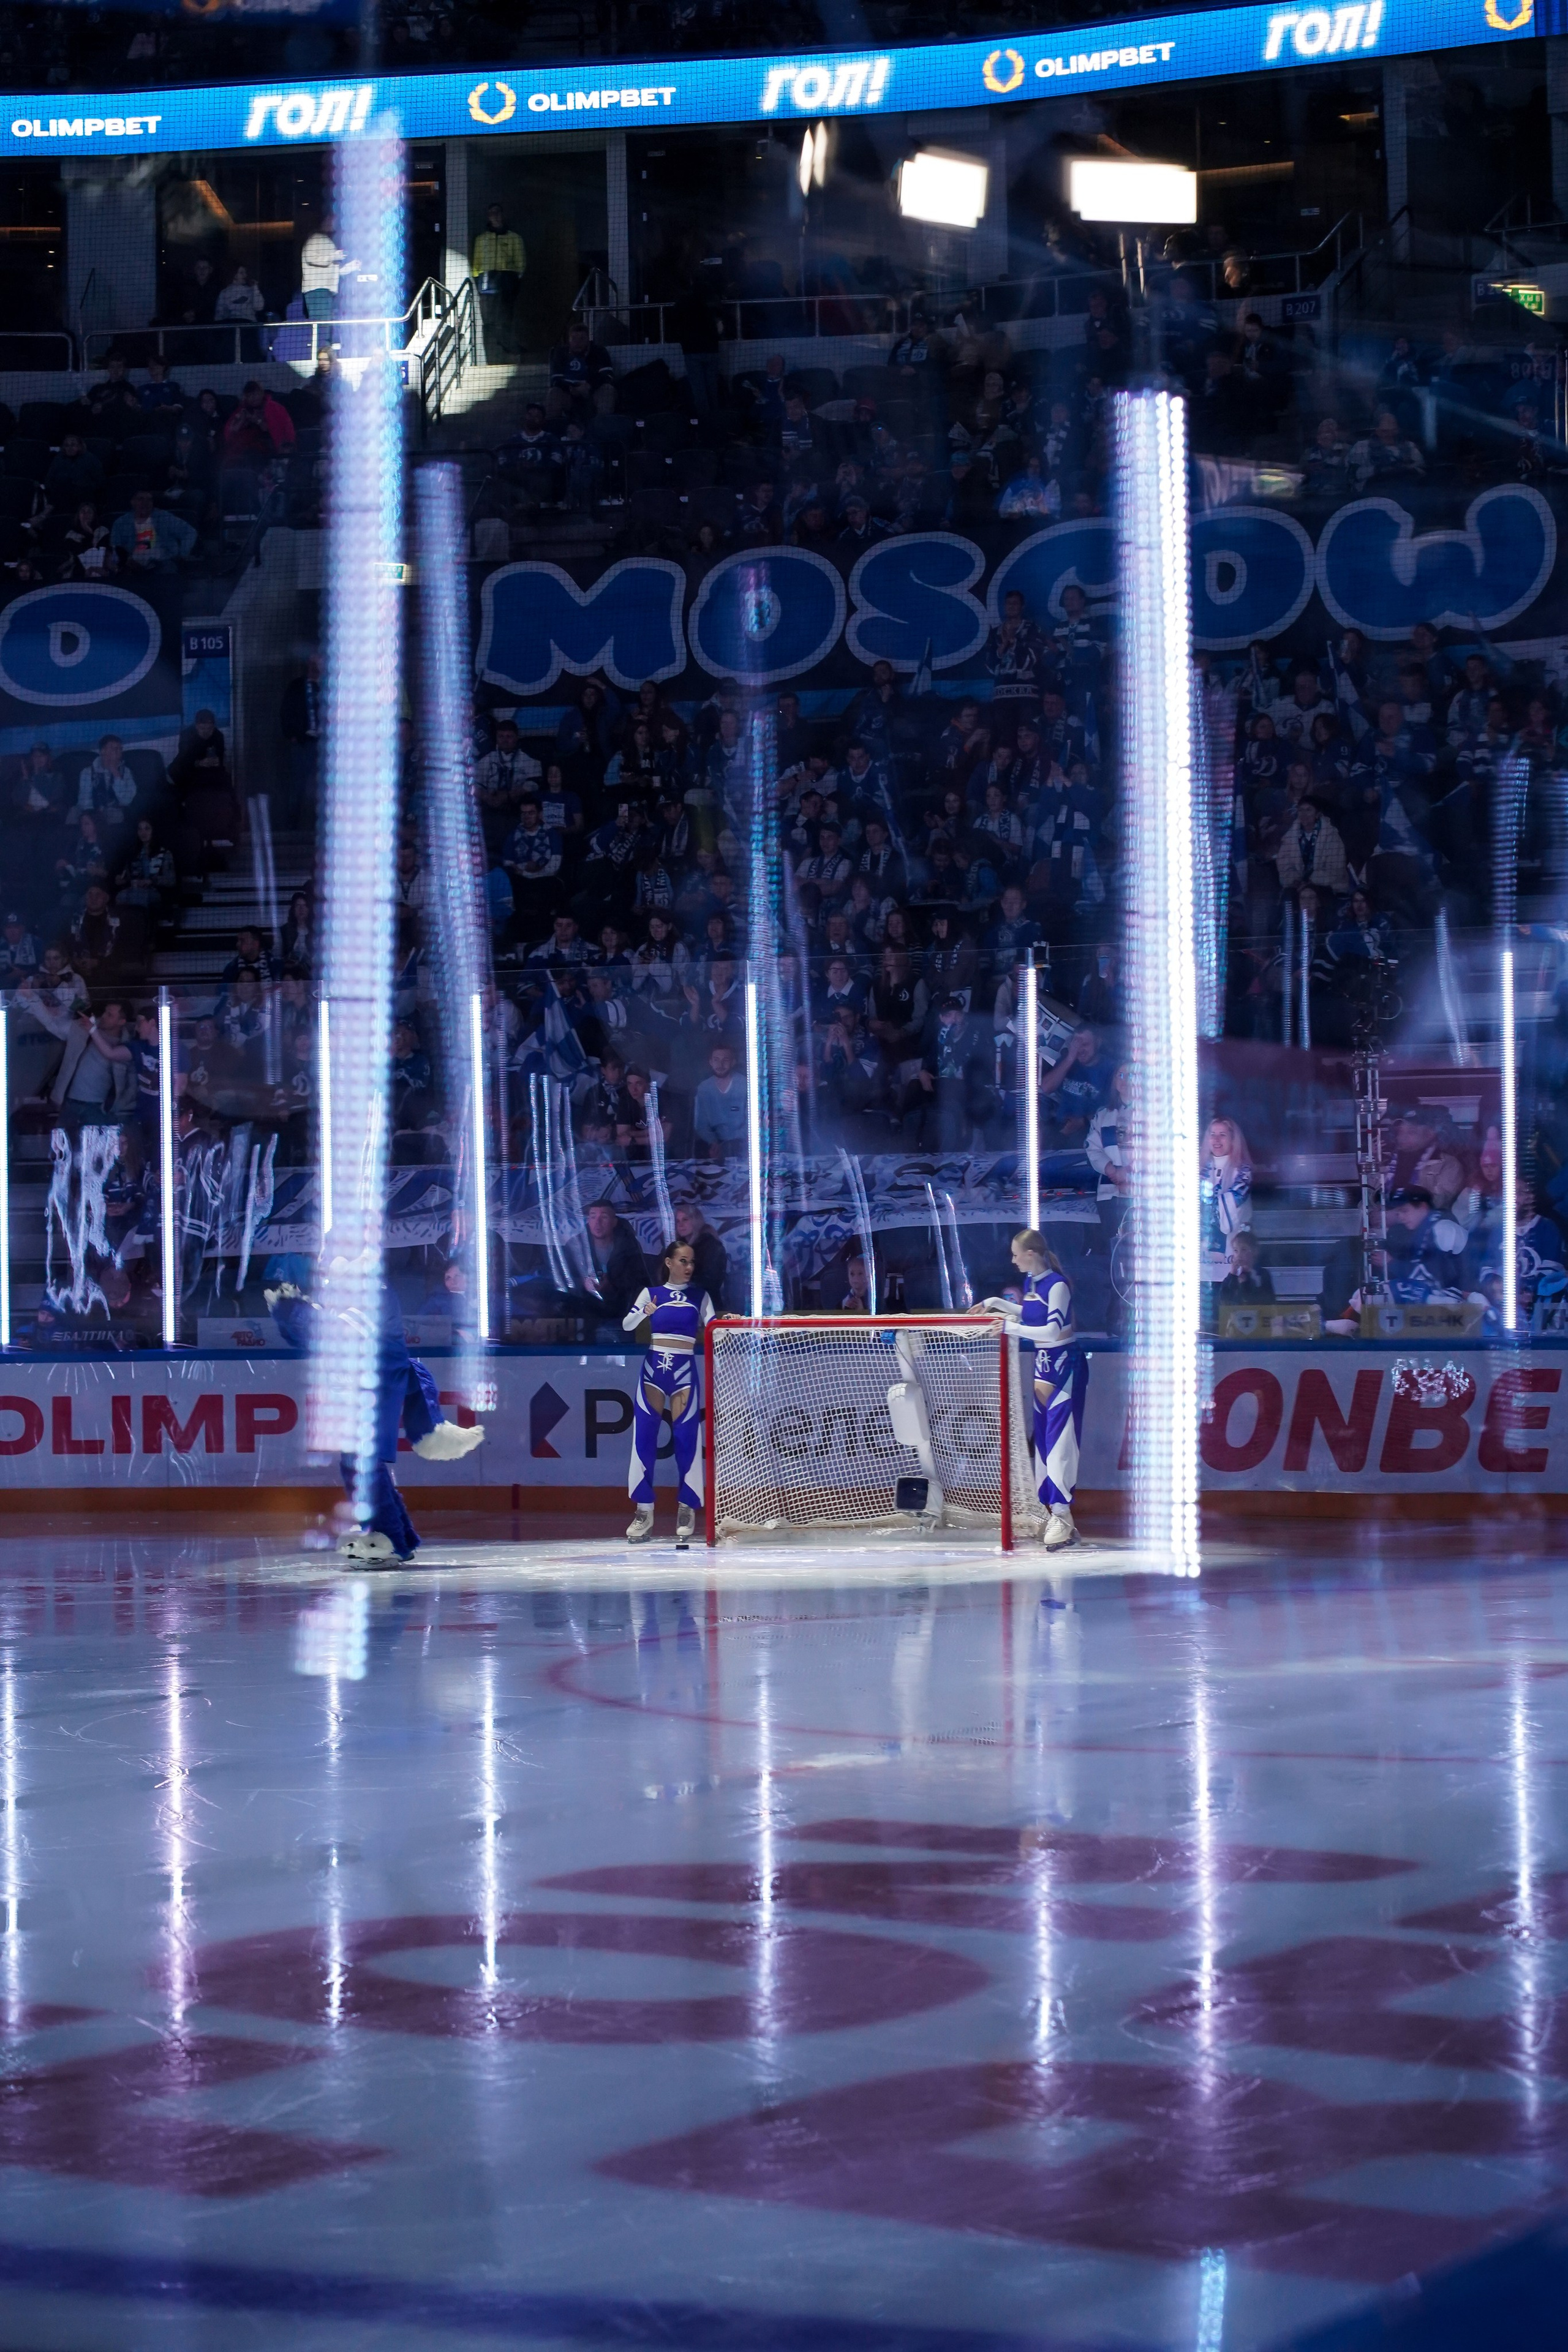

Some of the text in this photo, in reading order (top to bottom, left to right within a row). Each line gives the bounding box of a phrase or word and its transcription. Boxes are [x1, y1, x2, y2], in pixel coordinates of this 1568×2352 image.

[1035, 42, 1175, 78] OLIMPBET
[528, 87, 676, 111] OLIMPBET
[11, 115, 162, 137] OLIMPBET
[1294, 301, 1315, 315] 207
[475, 483, 1556, 695] MOSCOW
[201, 636, 224, 650] 105
[995, 687, 1035, 695] ОСКВА
[62, 1330, 124, 1341] БАЛТИКА
[1118, 1368, 1562, 1472] ONBE
